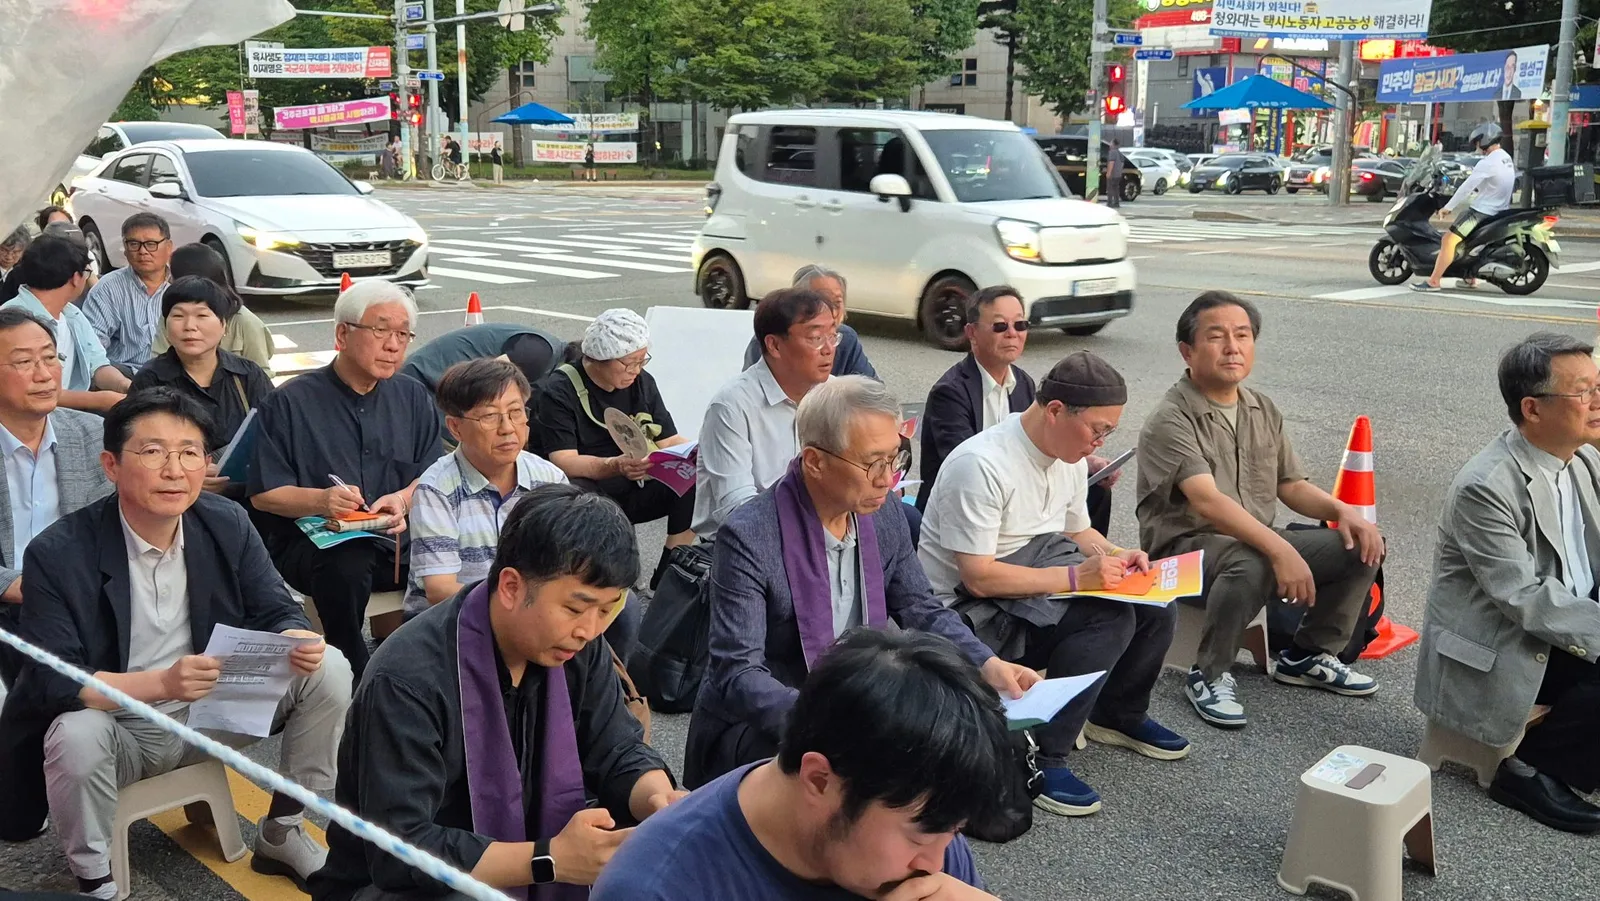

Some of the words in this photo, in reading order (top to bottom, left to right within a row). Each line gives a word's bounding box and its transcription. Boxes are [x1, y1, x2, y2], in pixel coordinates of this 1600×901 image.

[1215, 0, 1265, 11] 시민사회가
[1268, 1, 1301, 12] 외친다!
[1214, 12, 1261, 28] 청와대는
[1263, 16, 1321, 30] 택시노동자
[1325, 15, 1371, 30] 고공농성
[1373, 14, 1425, 29] 해결하라!
[252, 52, 282, 62] 육사생도
[253, 64, 282, 74] 이재명은
[1519, 60, 1544, 77] 맹성규
[1381, 69, 1414, 94] 민주의
[1413, 65, 1464, 94] 황금시대가
[1460, 68, 1502, 93] 열립니다!
